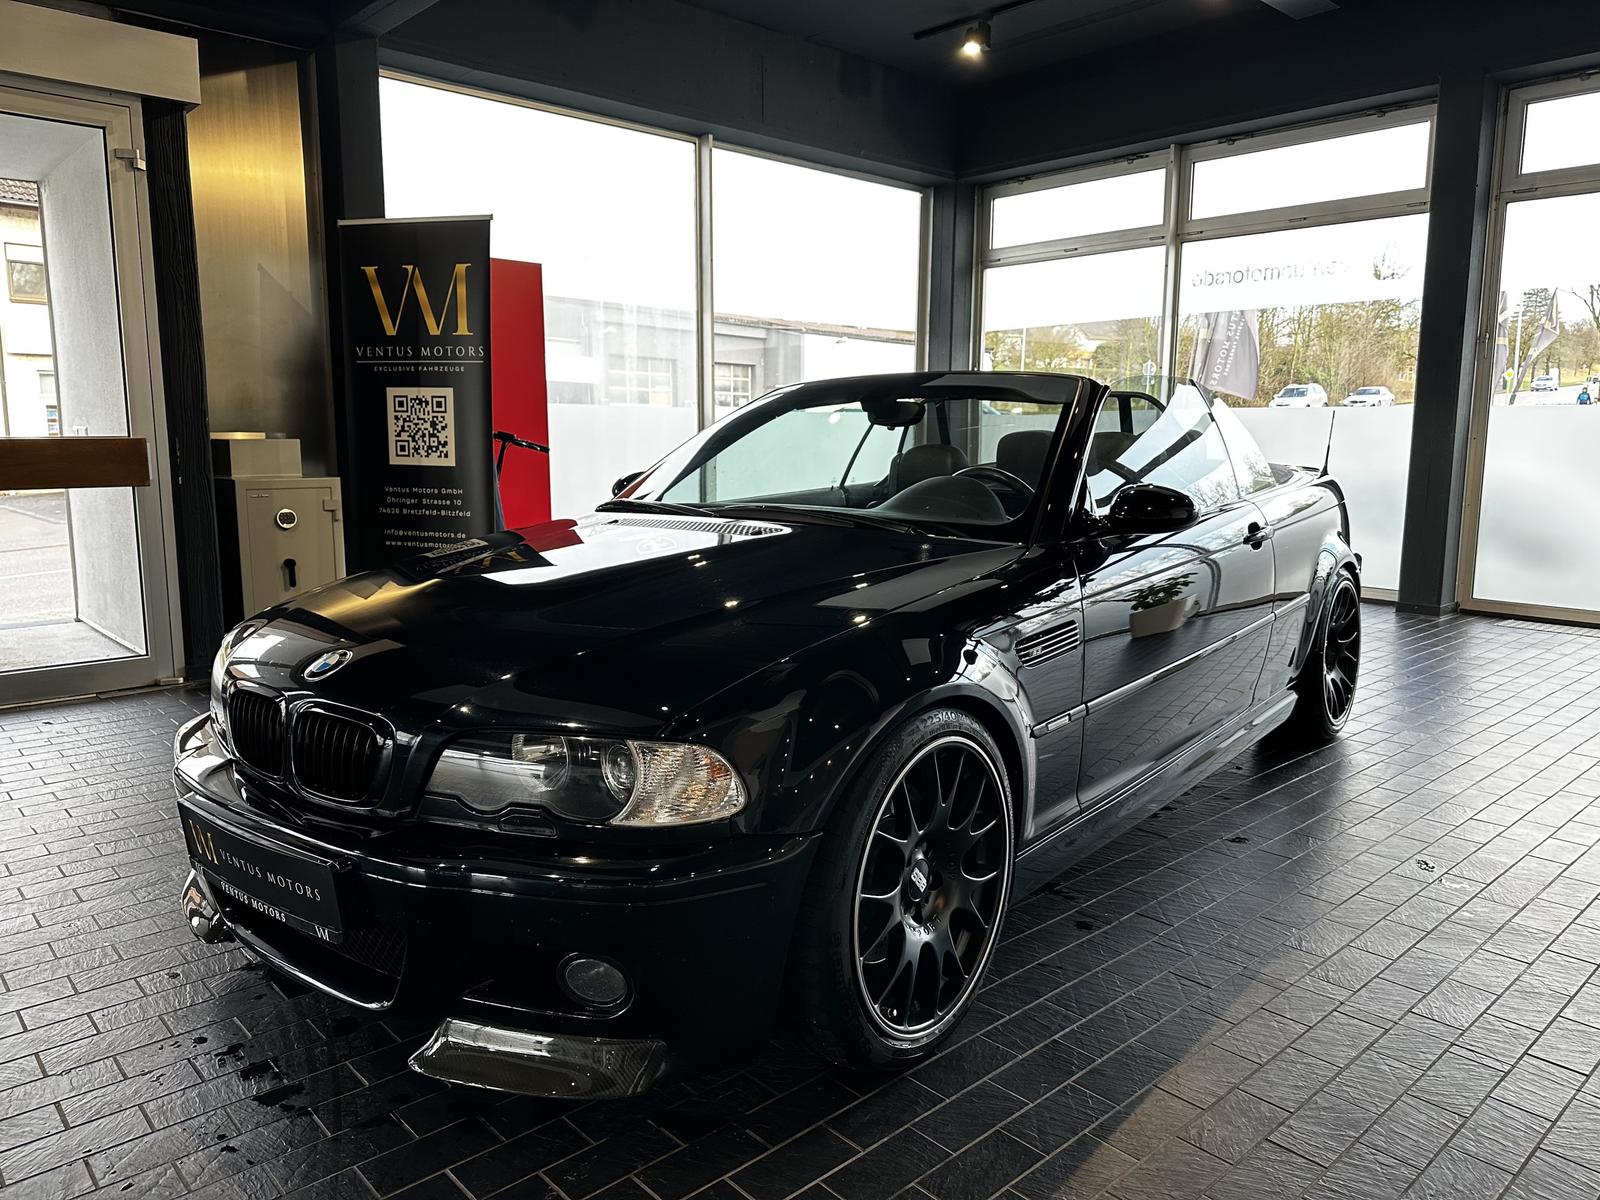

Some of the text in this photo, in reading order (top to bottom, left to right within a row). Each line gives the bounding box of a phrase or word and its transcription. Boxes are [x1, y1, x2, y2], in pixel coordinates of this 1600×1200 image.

[360, 263, 474, 336] VM
[356, 346, 484, 357] VENTUS MOTORS
[386, 496, 418, 505] Öhringer
[402, 508, 471, 517] Bretzfeld-Bitzfeld
[219, 849, 262, 878] VENTUS
[266, 871, 322, 901] MOTORS
[220, 881, 249, 904] VENTUS
[251, 898, 287, 923] MOTORS
